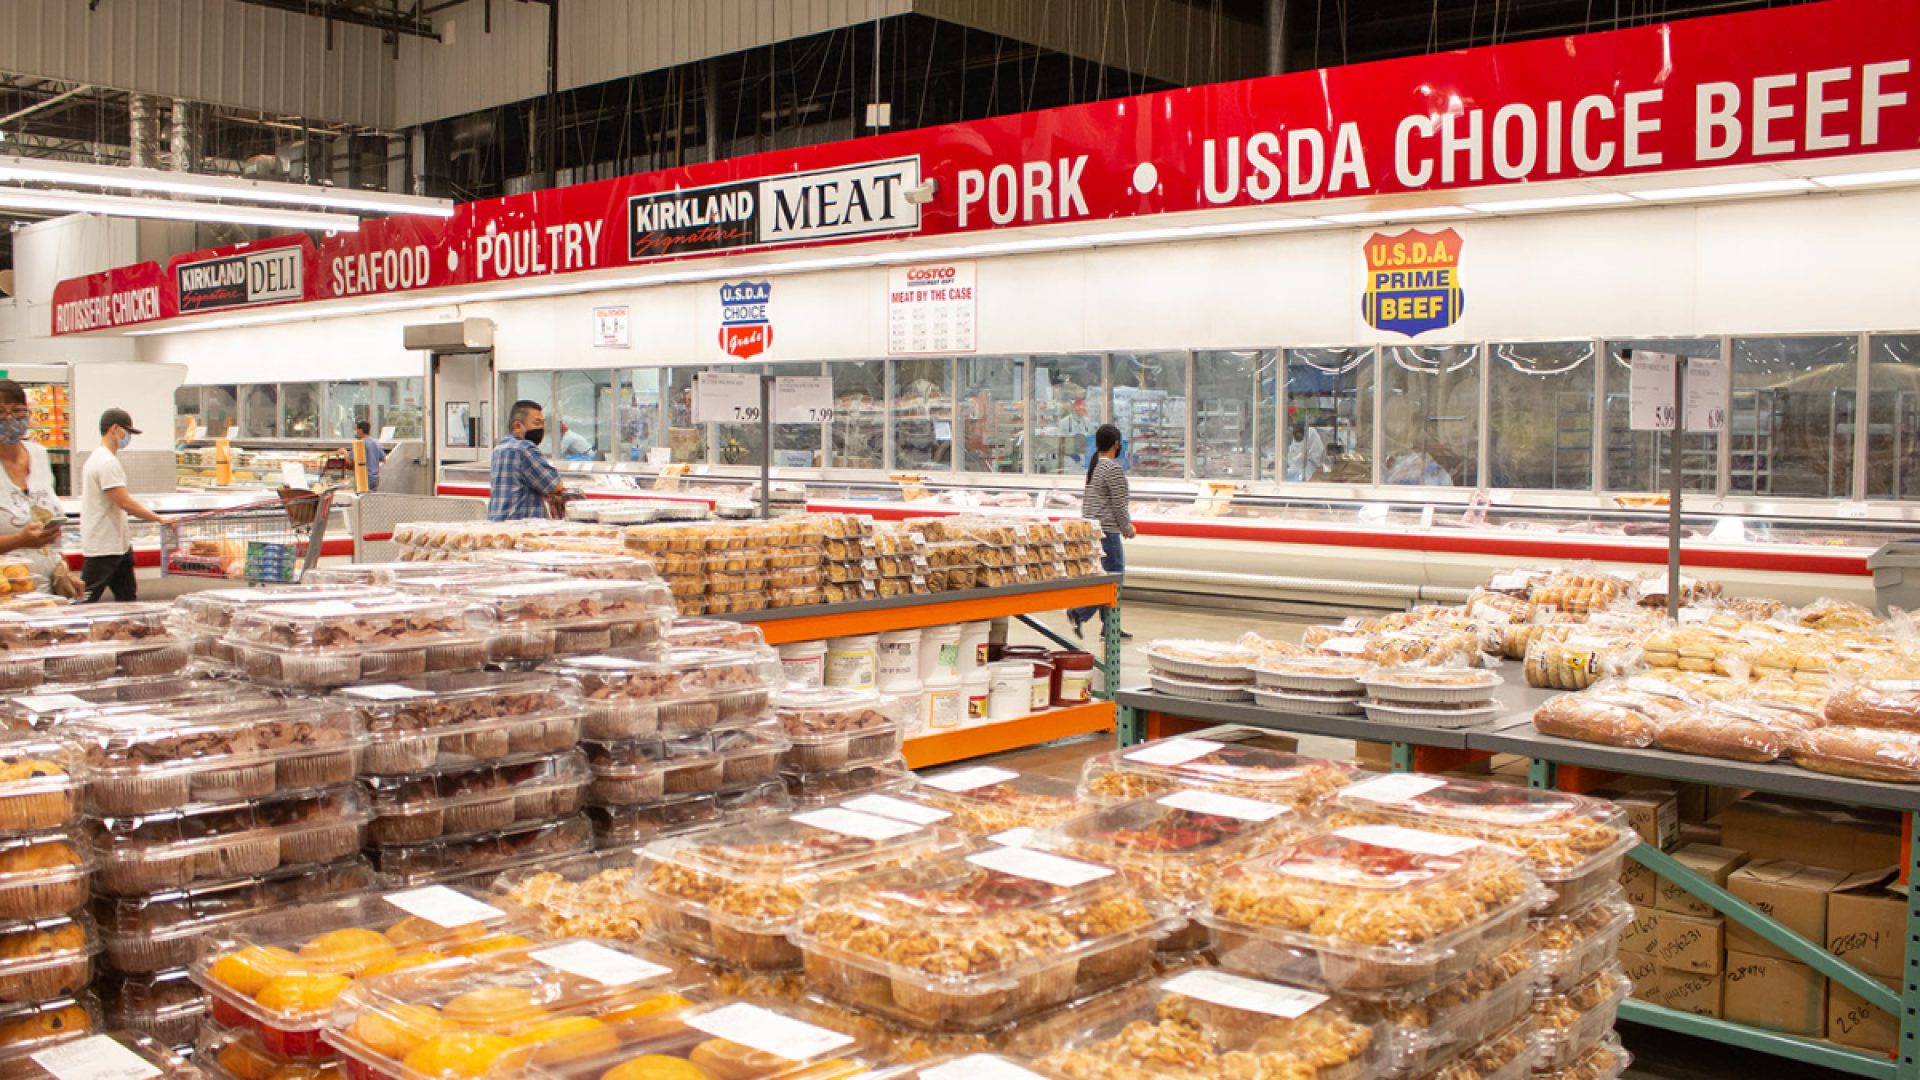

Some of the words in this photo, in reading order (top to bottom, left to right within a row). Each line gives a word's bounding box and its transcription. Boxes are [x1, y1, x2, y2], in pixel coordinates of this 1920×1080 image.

[1203, 122, 1370, 204] USDA
[1395, 89, 1663, 188] CHOICE
[1695, 59, 1910, 161] BEEF
[772, 173, 902, 232] MEAT
[957, 154, 1089, 228] PORK
[637, 191, 753, 232] KIRKLAND
[476, 219, 603, 279] POULTRY
[635, 226, 752, 256] Signature
[1372, 240, 1454, 267] U.S.D.A.
[182, 261, 246, 292] KIRKLAND
[251, 255, 297, 294] DELI
[332, 245, 430, 296] SEAFOOD
[907, 267, 956, 281] COSTCO
[1376, 269, 1450, 289] PRIME
[181, 287, 245, 309] Signature
[723, 286, 769, 301] U.S.D.A.
[891, 291, 914, 304] MEAT
[916, 290, 928, 302] BY
[930, 288, 946, 301] THE
[948, 287, 972, 300] CASE
[56, 295, 111, 333] ROTISSERIE
[112, 286, 161, 326] CHICKEN
[723, 305, 766, 320] CHOICE
[1380, 295, 1444, 320] BEEF
[729, 329, 763, 353] Grade
[734, 406, 760, 420] 7.99
[809, 407, 834, 422] 7.99
[1655, 405, 1675, 428] 5.99
[1708, 408, 1725, 429] 6.99
